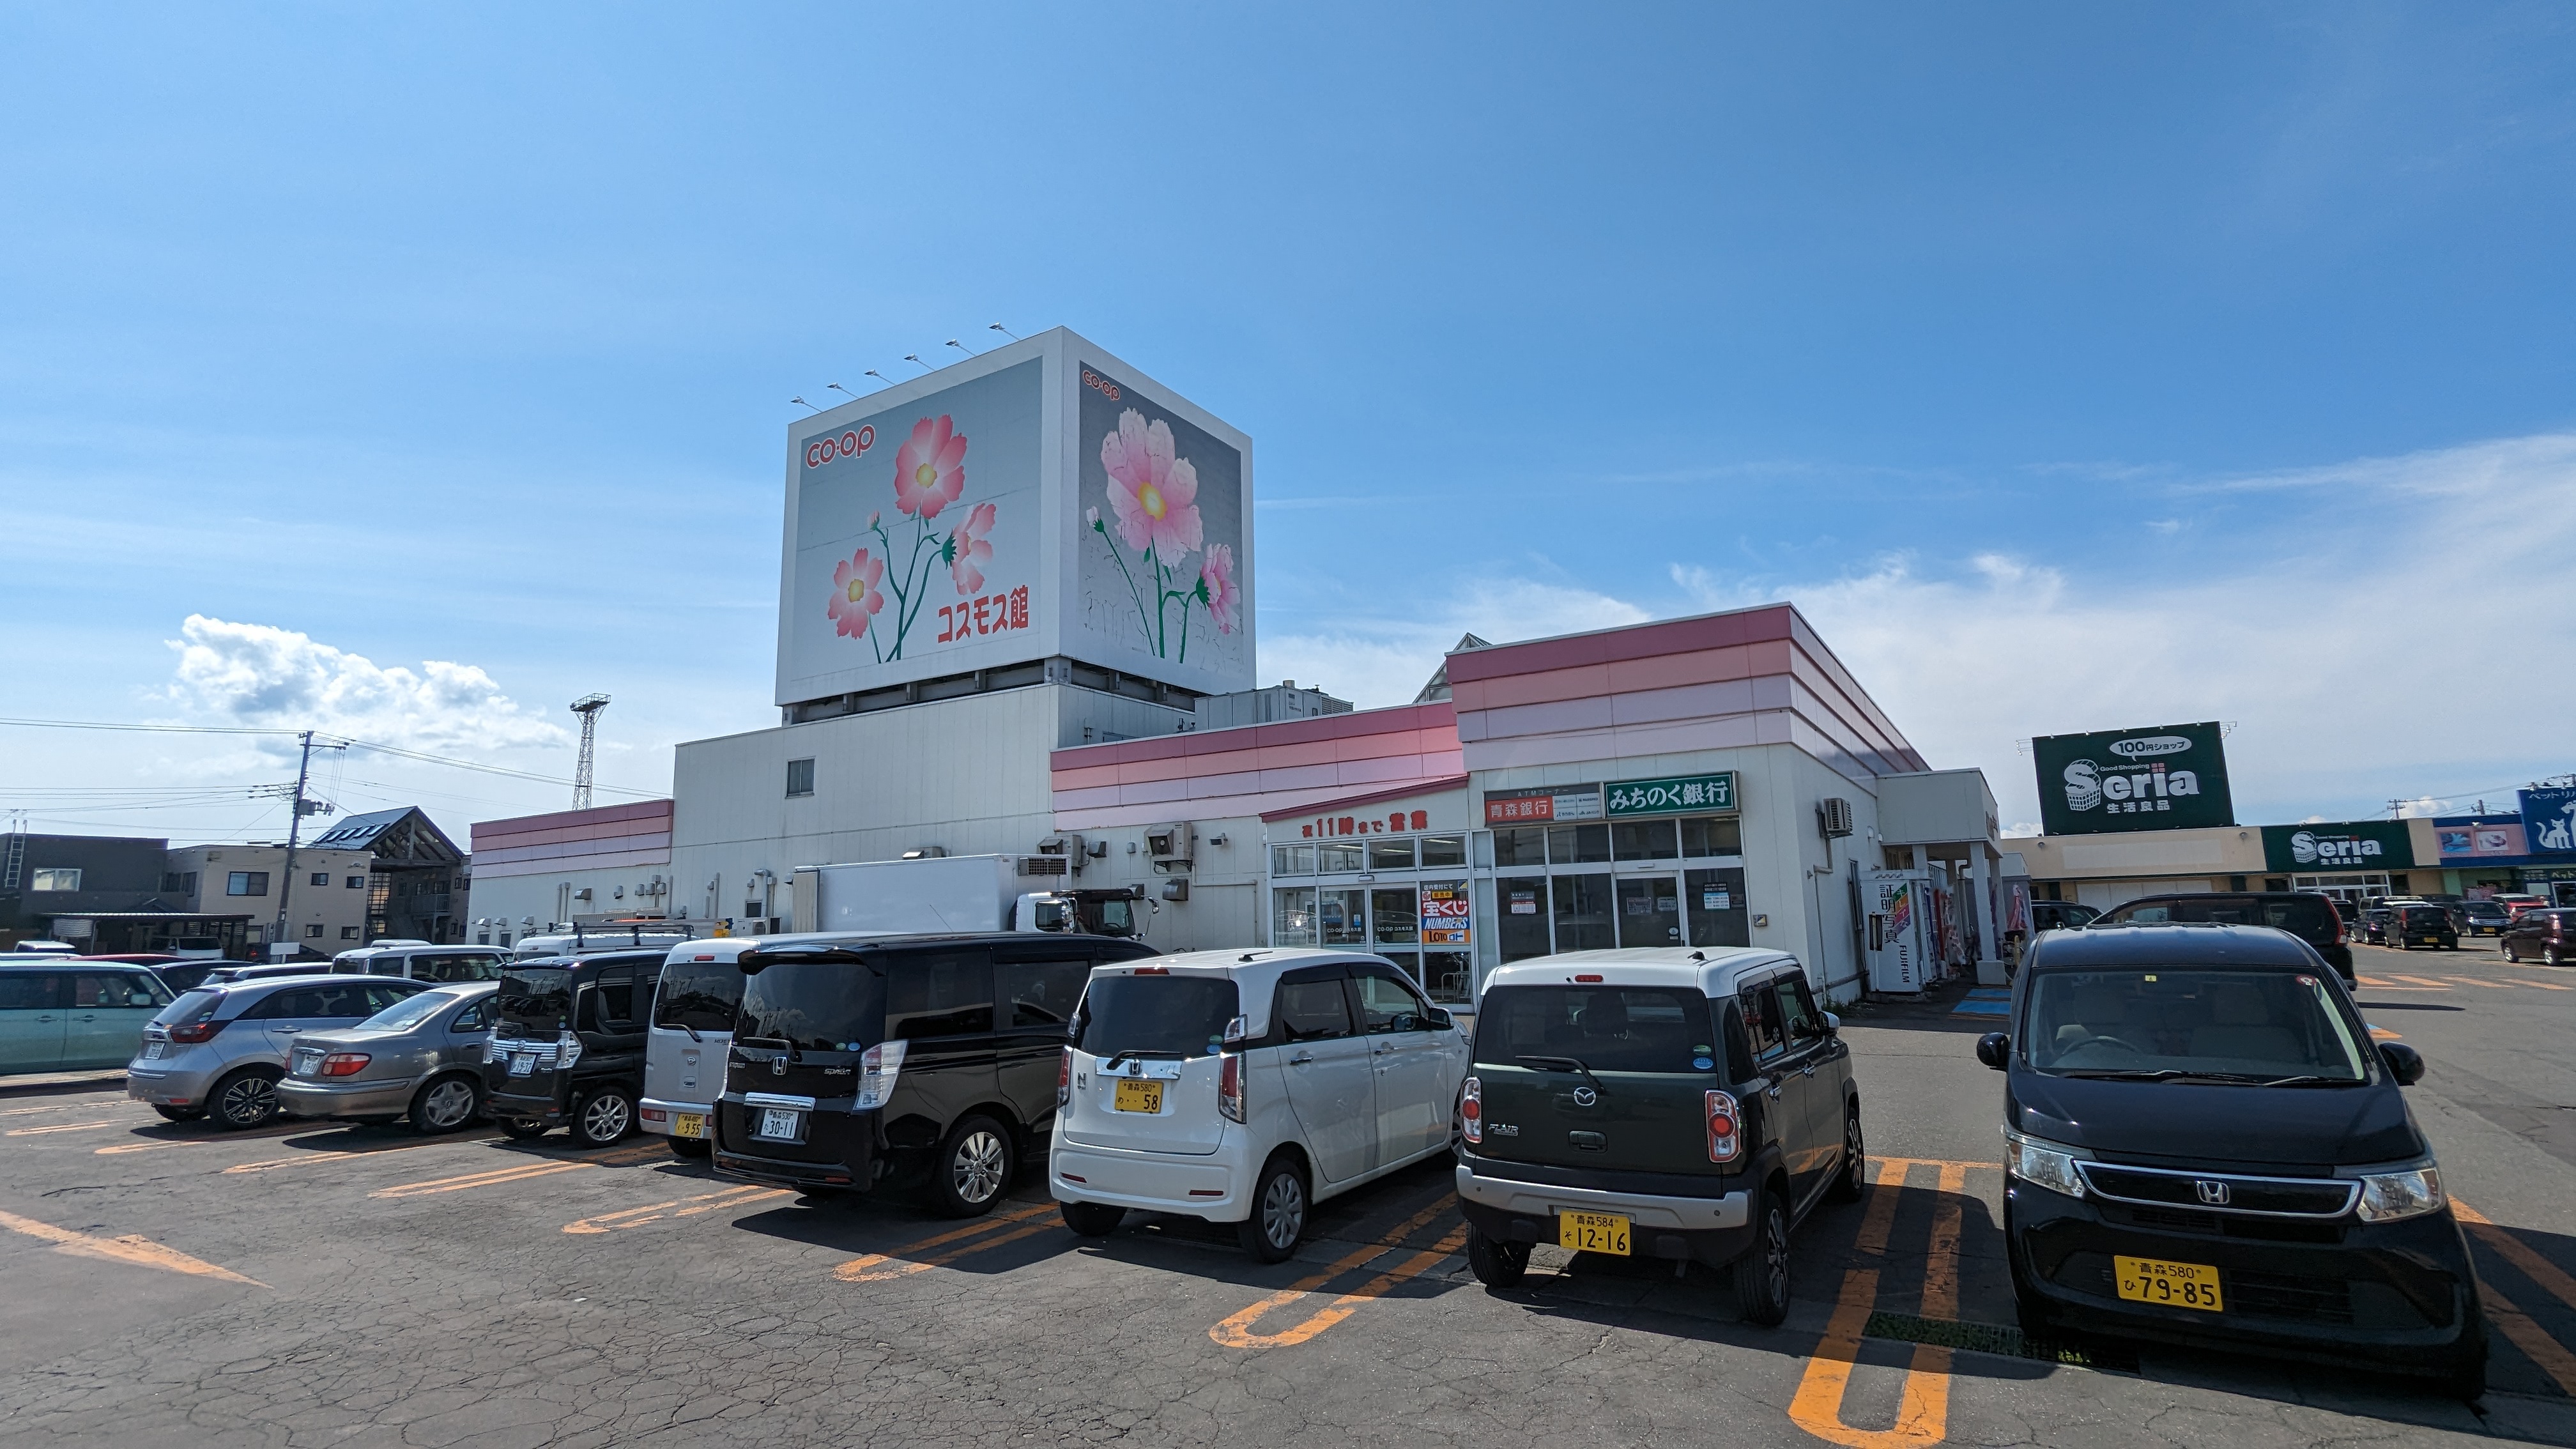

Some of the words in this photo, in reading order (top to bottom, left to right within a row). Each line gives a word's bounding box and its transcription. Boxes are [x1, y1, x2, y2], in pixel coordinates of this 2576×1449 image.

[938, 585, 1029, 643] コスモス館
[2118, 741, 2186, 753] 100円ショップ
[1517, 788, 1569, 797] ATMコーナー
[1609, 780, 1728, 810] みちのく銀行
[2064, 759, 2200, 811] Seria
[1491, 800, 1548, 818] 青森銀行
[2107, 800, 2170, 814] 生活良品
[2291, 831, 2382, 862] Seria
[1423, 900, 1468, 916] 宝くじ
[1879, 884, 1899, 944] 証明写真
[1424, 917, 1468, 930] NUMBERS
[1429, 931, 1448, 942] LOTO
[1899, 946, 1910, 983] FUJIFILM
[1578, 1227, 1626, 1251] 12-16
[2124, 1279, 2136, 1291] ひ
[2138, 1276, 2216, 1306] 79-85
